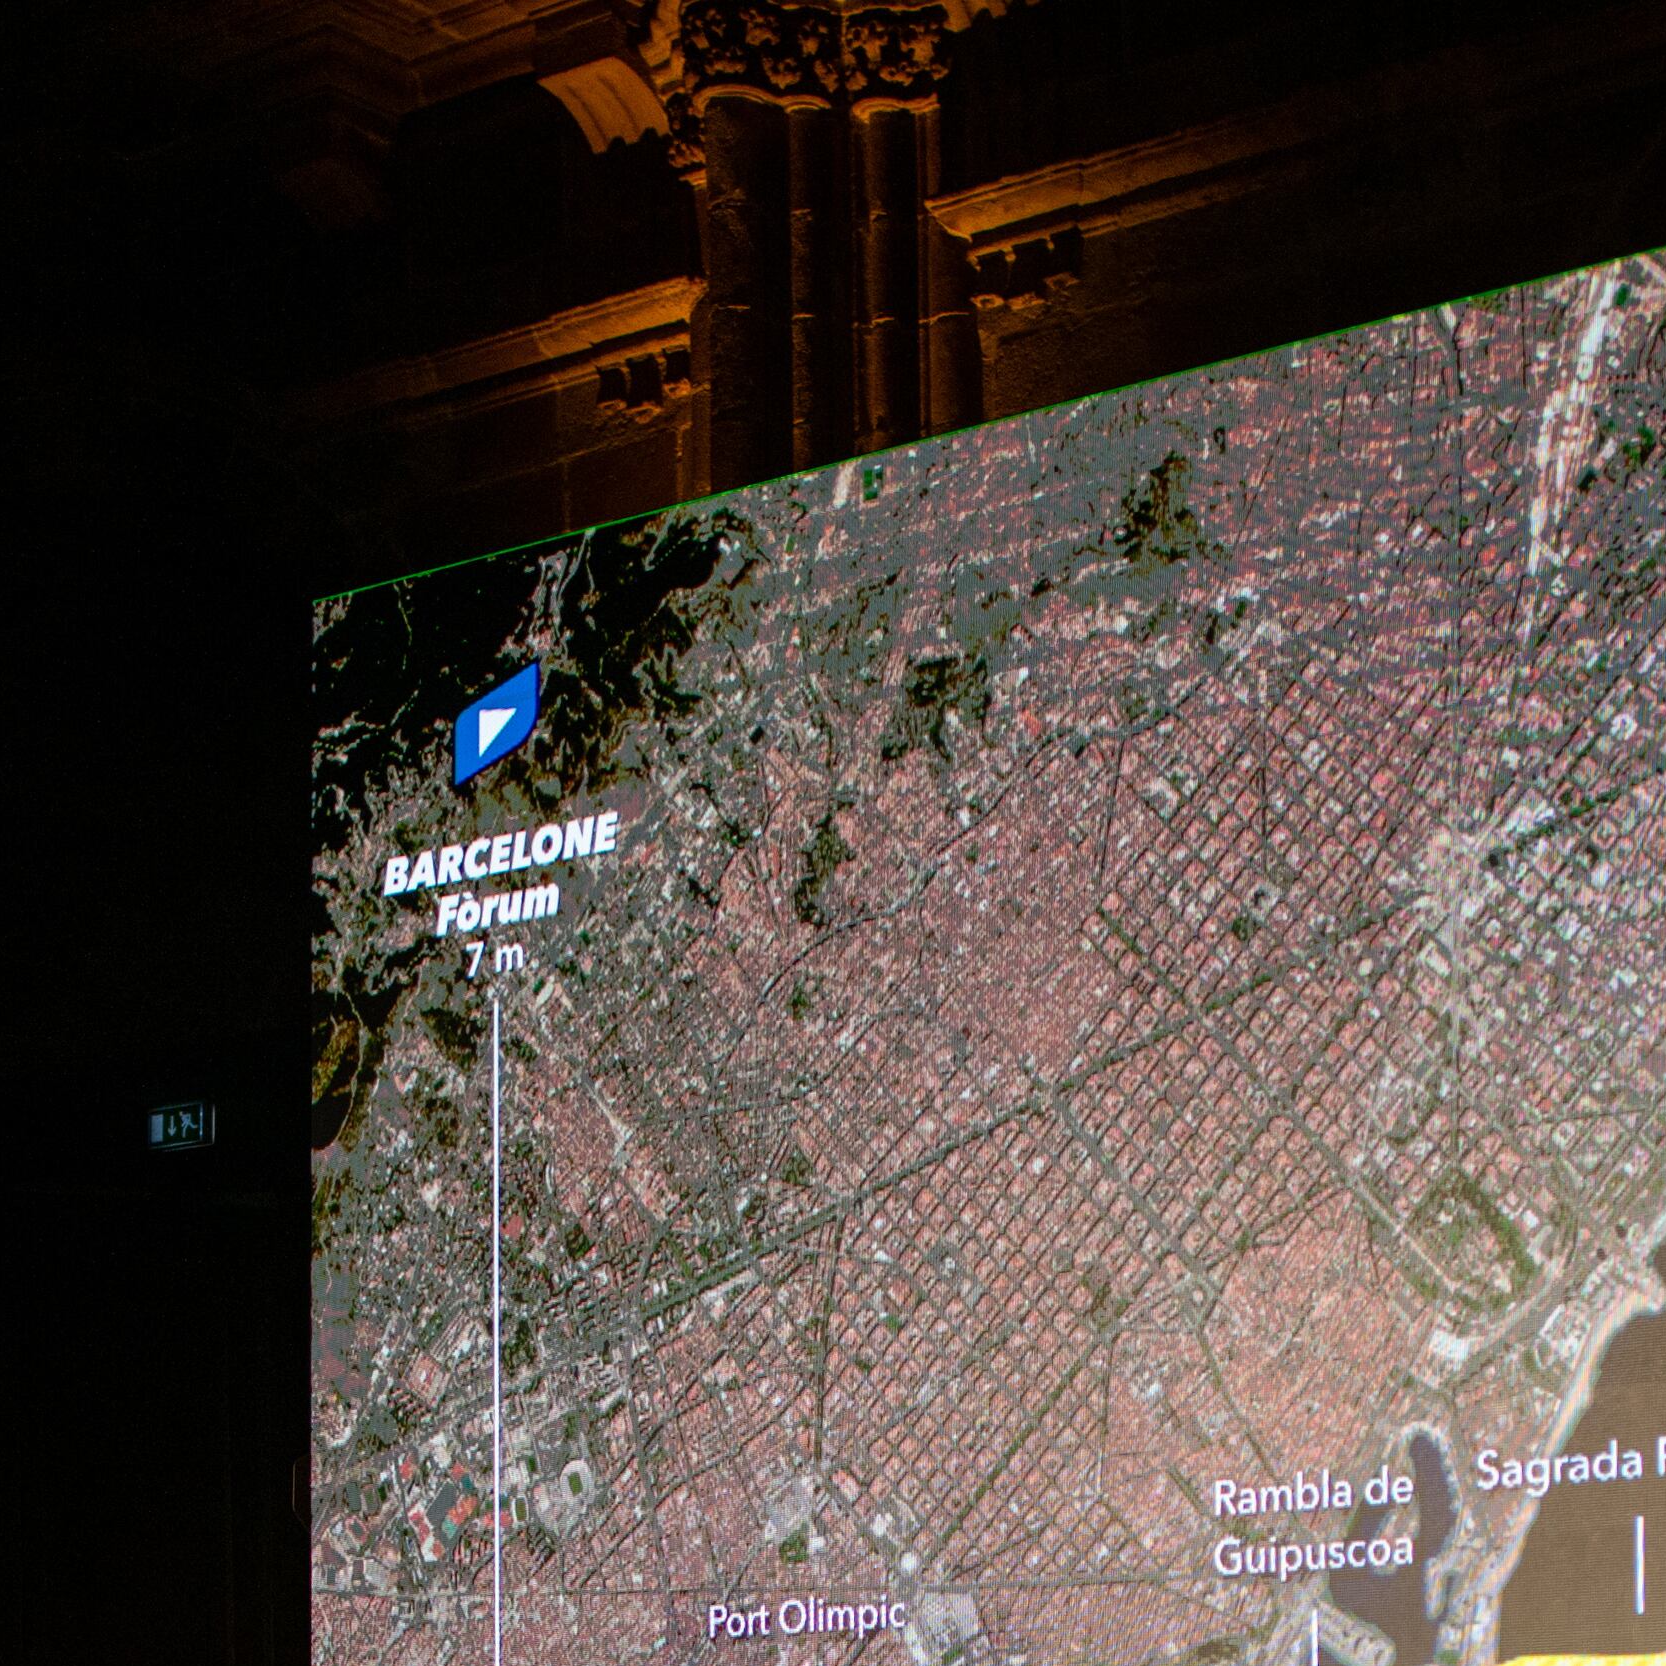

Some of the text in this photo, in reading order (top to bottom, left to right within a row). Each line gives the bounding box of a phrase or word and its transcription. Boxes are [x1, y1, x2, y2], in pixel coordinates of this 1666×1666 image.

[383, 811, 619, 897] BARCELONE
[436, 882, 560, 938] Fòrum
[465, 940, 523, 980] 7 m
[1213, 1465, 1414, 1516] Rambla de
[1476, 1439, 1644, 1498] Sagrada
[1213, 1533, 1414, 1583] Guipuscoa
[709, 1604, 771, 1639] Port
